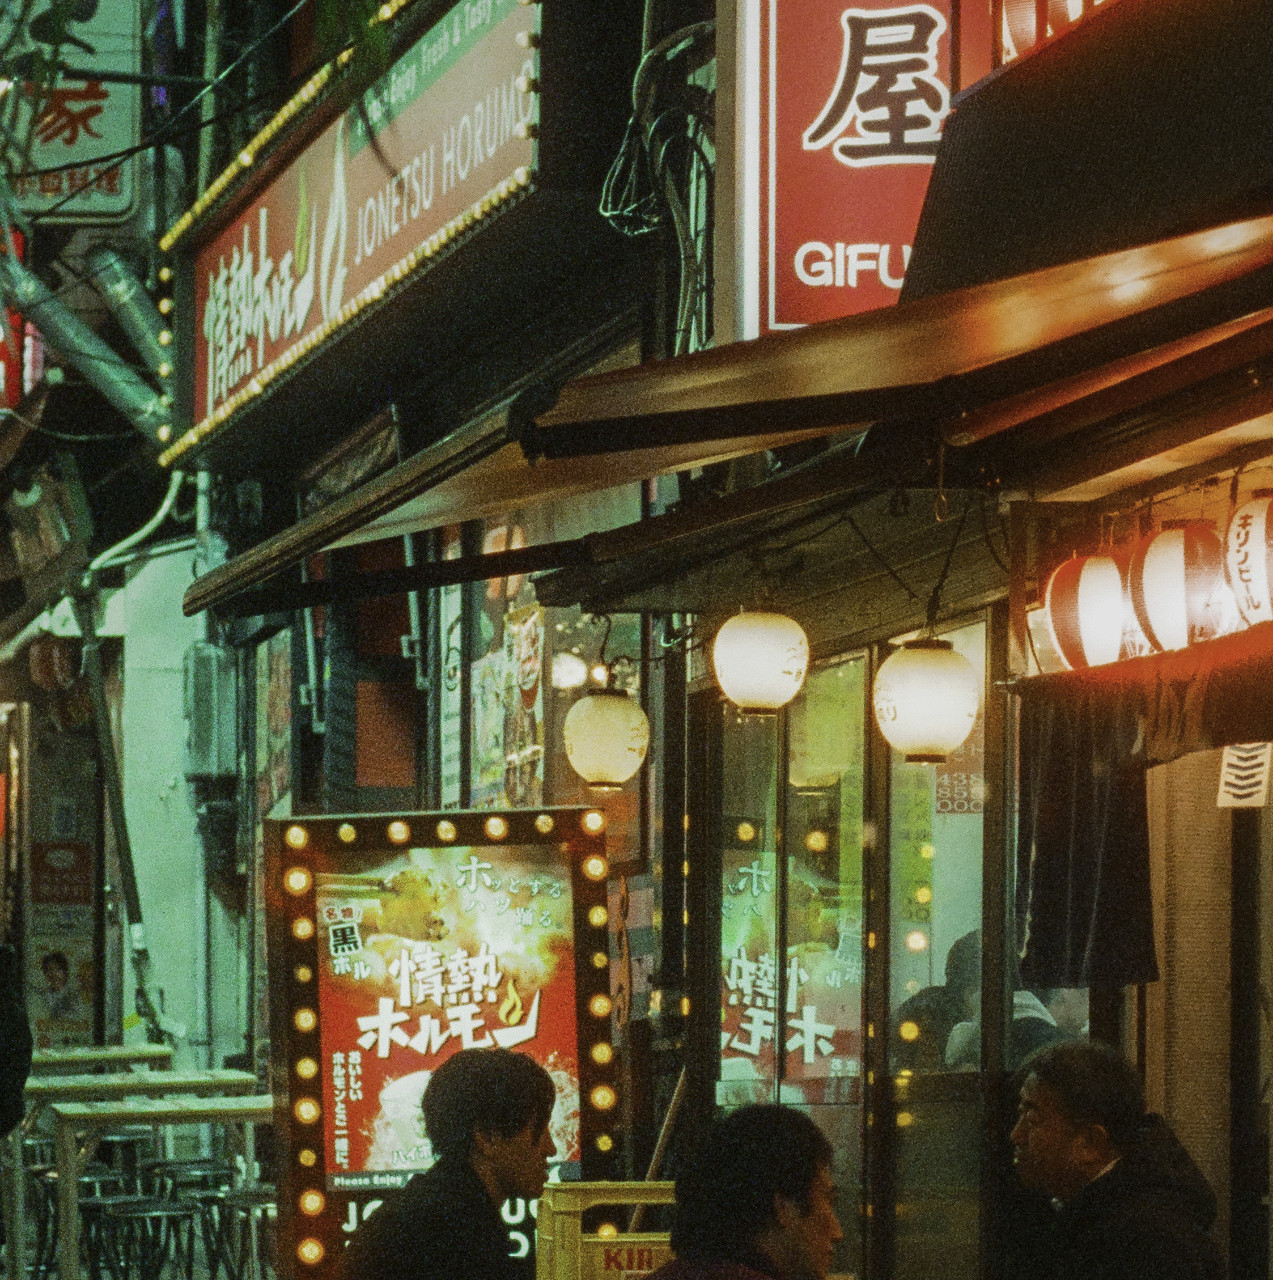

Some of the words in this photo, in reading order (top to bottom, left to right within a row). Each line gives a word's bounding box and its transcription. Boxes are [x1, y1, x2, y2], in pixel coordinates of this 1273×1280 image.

[354, 143, 435, 266] JONETSU
[794, 241, 912, 289] GIFU
[1236, 513, 1262, 611] キリンビール
[331, 924, 361, 956] 黒
[332, 955, 372, 981] ホル
[388, 941, 503, 1008] 情熱
[356, 988, 541, 1060] ホルモン
[348, 1050, 363, 1101] おいしい
[373, 1174, 403, 1188] Enjoy
